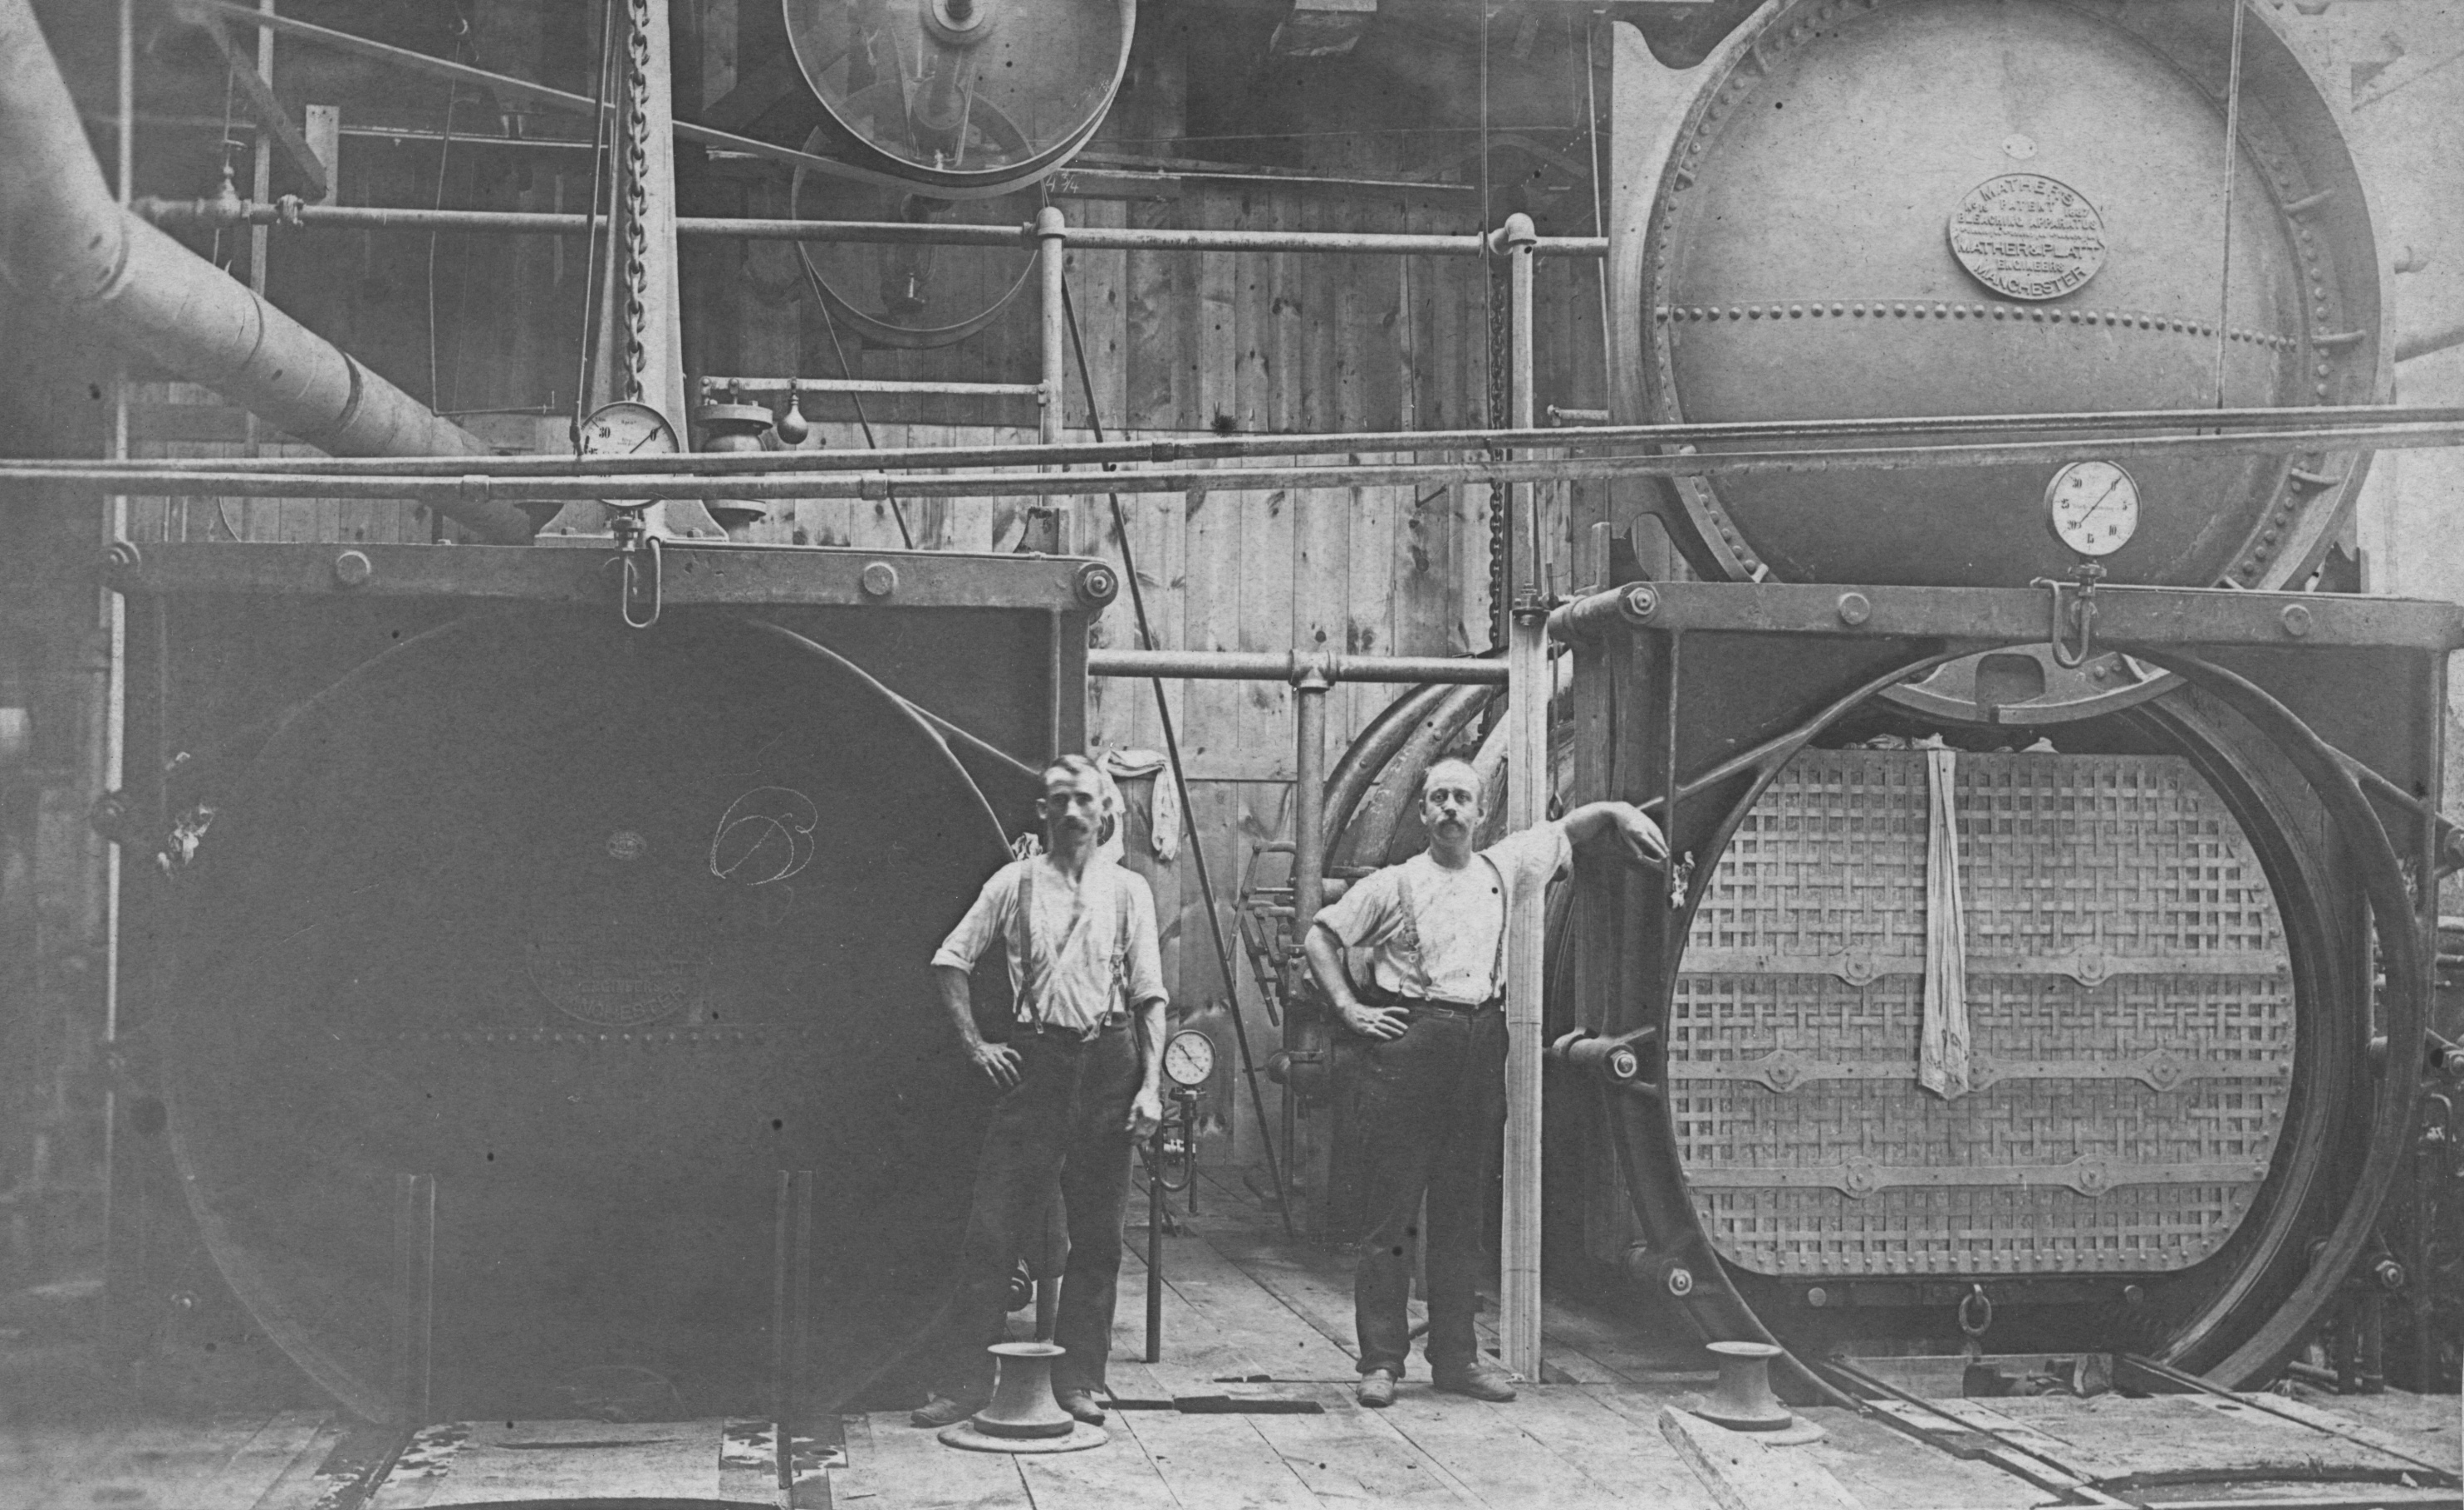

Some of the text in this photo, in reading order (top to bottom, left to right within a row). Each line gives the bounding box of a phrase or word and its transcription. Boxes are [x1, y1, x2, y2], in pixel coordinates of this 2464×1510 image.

[2000, 199, 2055, 213] PATENT
[1956, 212, 2098, 231] BLEACHING APPARATUS
[1996, 259, 2065, 273] ENGINEERS
[1973, 266, 2087, 297] MANCHESTER
[598, 426, 611, 439] 30
[2072, 478, 2083, 489] 30
[2108, 524, 2118, 536] 10
[555, 983, 687, 1021] NCHESTER
